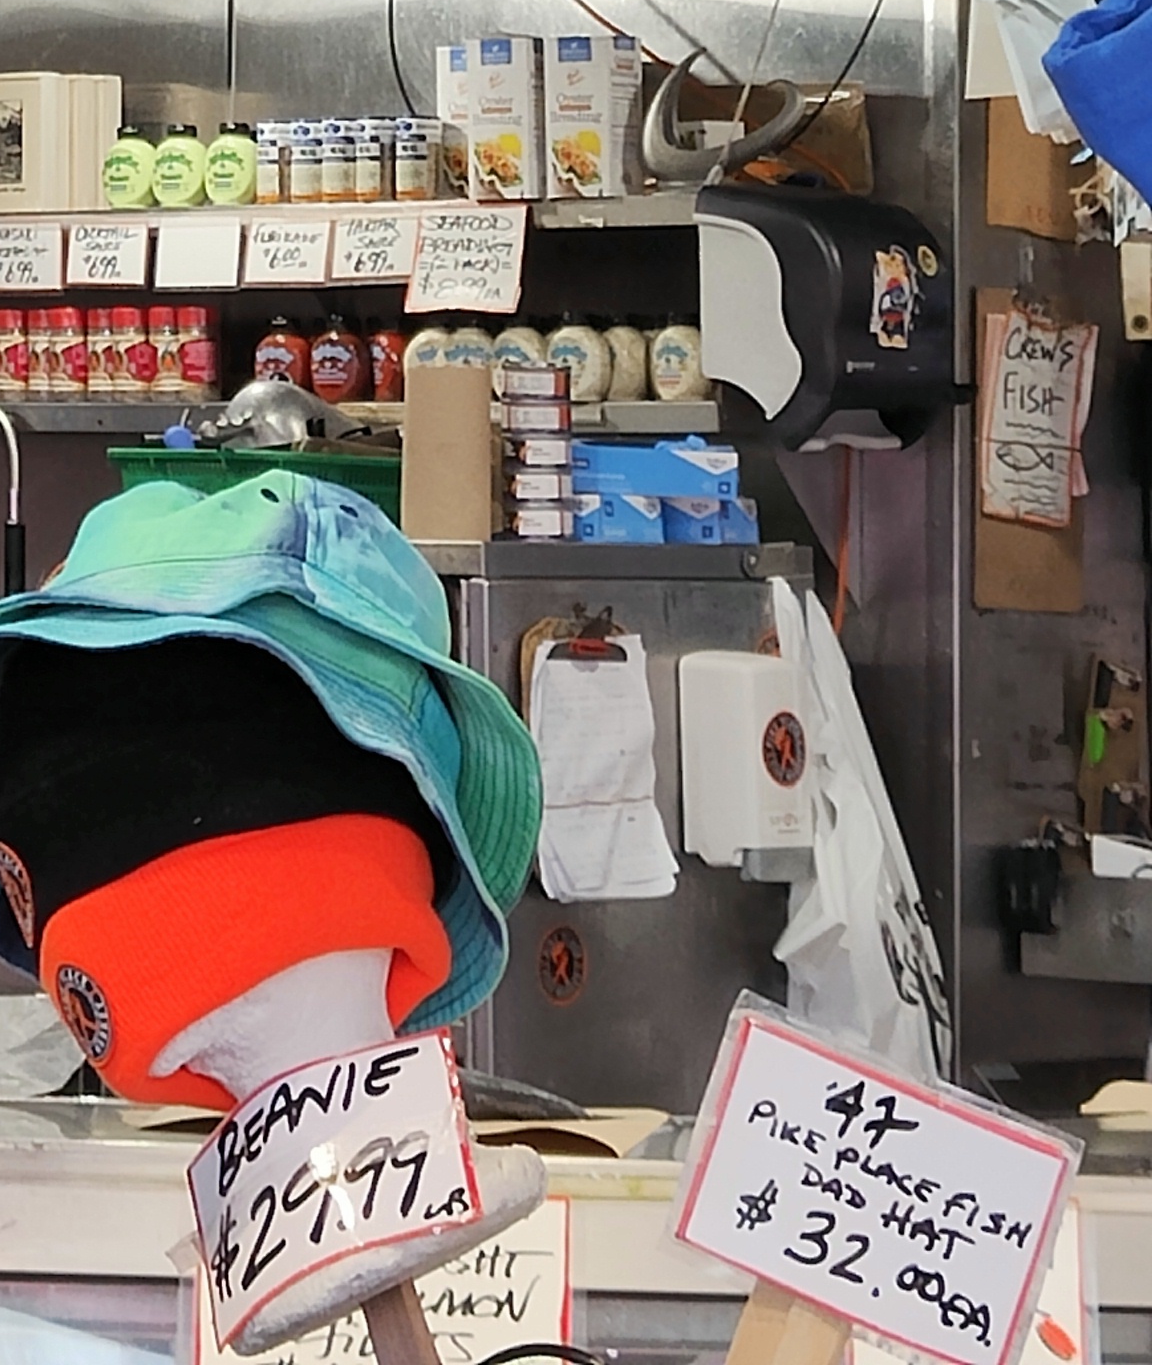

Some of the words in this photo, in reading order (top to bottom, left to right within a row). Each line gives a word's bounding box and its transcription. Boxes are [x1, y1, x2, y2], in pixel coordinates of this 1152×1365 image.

[423, 214, 514, 233] SEAFOOD
[1005, 327, 1074, 372] CREWS
[1004, 372, 1065, 417] FISH
[216, 1046, 420, 1197] BEANIE
[748, 1100, 826, 1155] PIKE
[834, 1146, 943, 1204] PLACE
[943, 1192, 1033, 1249] FISH
[800, 1163, 867, 1210] DAD
[879, 1200, 976, 1261] HAT
